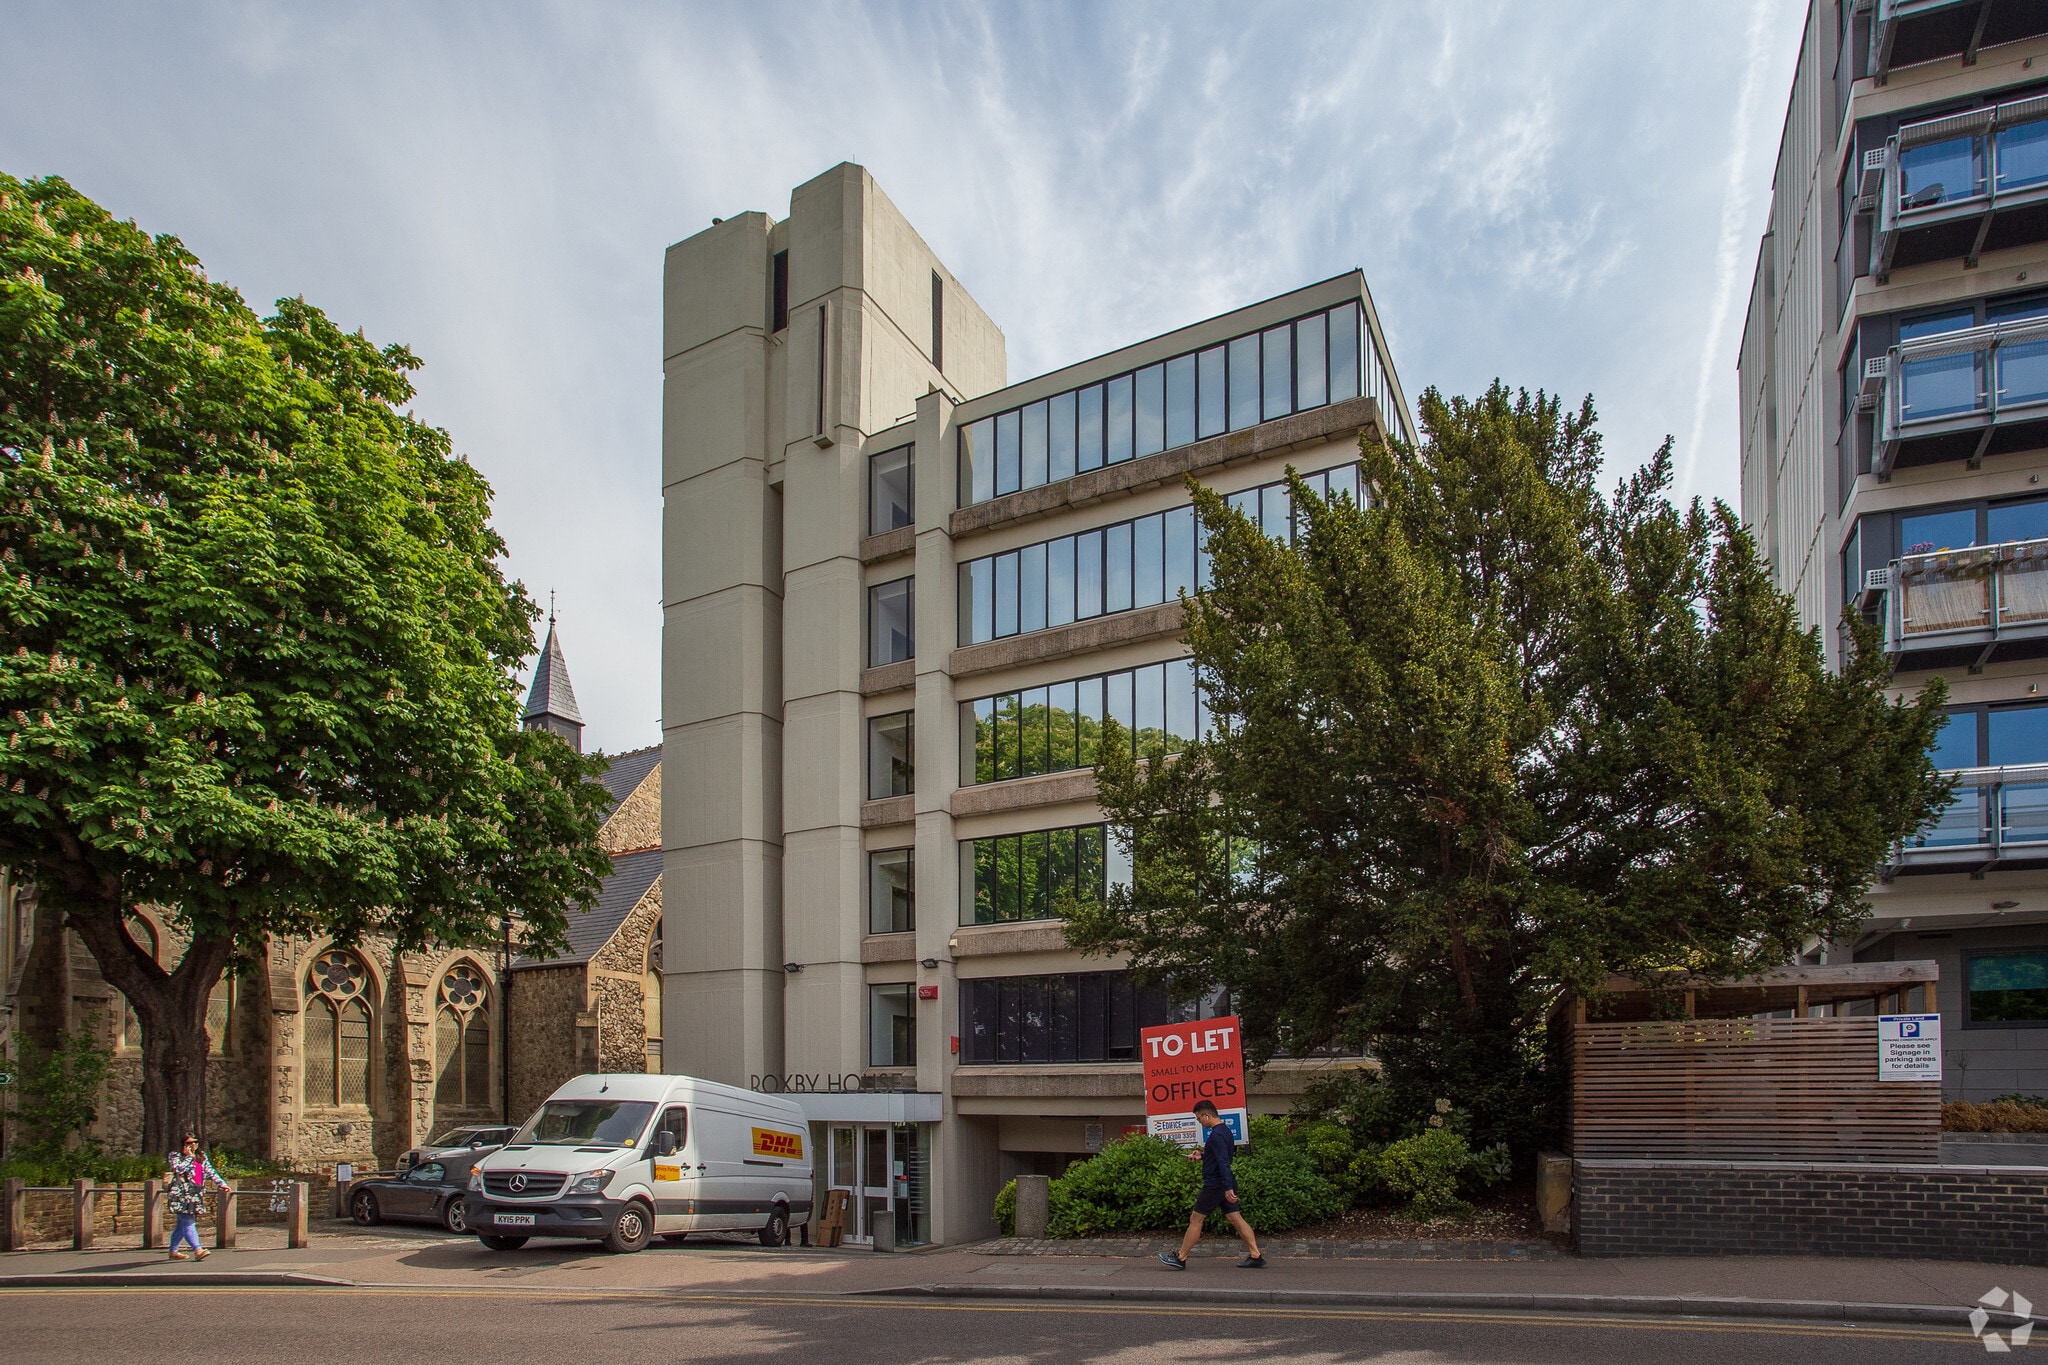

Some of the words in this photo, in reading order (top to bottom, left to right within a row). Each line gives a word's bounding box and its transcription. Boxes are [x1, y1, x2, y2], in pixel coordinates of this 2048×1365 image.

[1902, 1023, 1917, 1037] P
[1146, 1034, 1184, 1058] TO
[1190, 1027, 1234, 1054] LET
[1151, 1067, 1179, 1078] SMALL
[1181, 1064, 1194, 1074] TO
[1196, 1061, 1235, 1073] MEDIUM
[750, 1073, 820, 1094] ROXBY
[828, 1072, 904, 1094] HOUSE
[1151, 1077, 1238, 1103] OFFICES
[1162, 1121, 1182, 1131] EDIFICE
[760, 1133, 797, 1155] DHL
[498, 1215, 514, 1224] KY15
[515, 1216, 531, 1224] PPK
